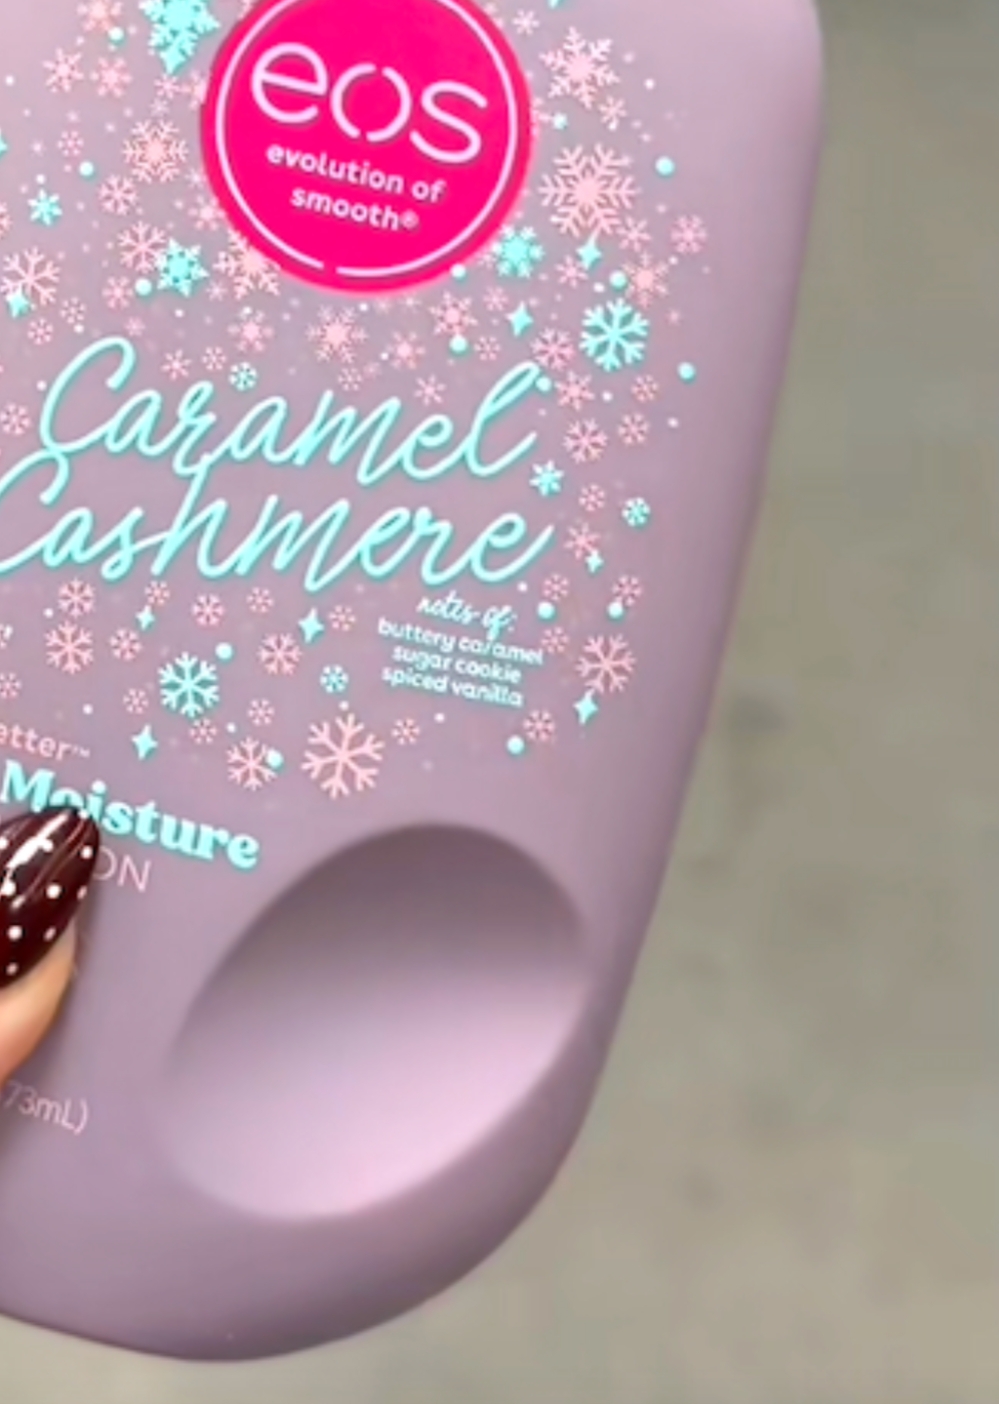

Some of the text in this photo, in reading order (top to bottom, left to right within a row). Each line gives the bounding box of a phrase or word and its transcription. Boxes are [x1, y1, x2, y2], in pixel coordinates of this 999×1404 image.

[252, 42, 488, 164] eos
[266, 143, 447, 204] evolution of
[39, 336, 541, 486] Caramel
[416, 590, 481, 626] notes
[377, 616, 544, 665] buttery caramel
[391, 645, 523, 684] sugar cookie
[381, 666, 524, 708] spiced vanilla
